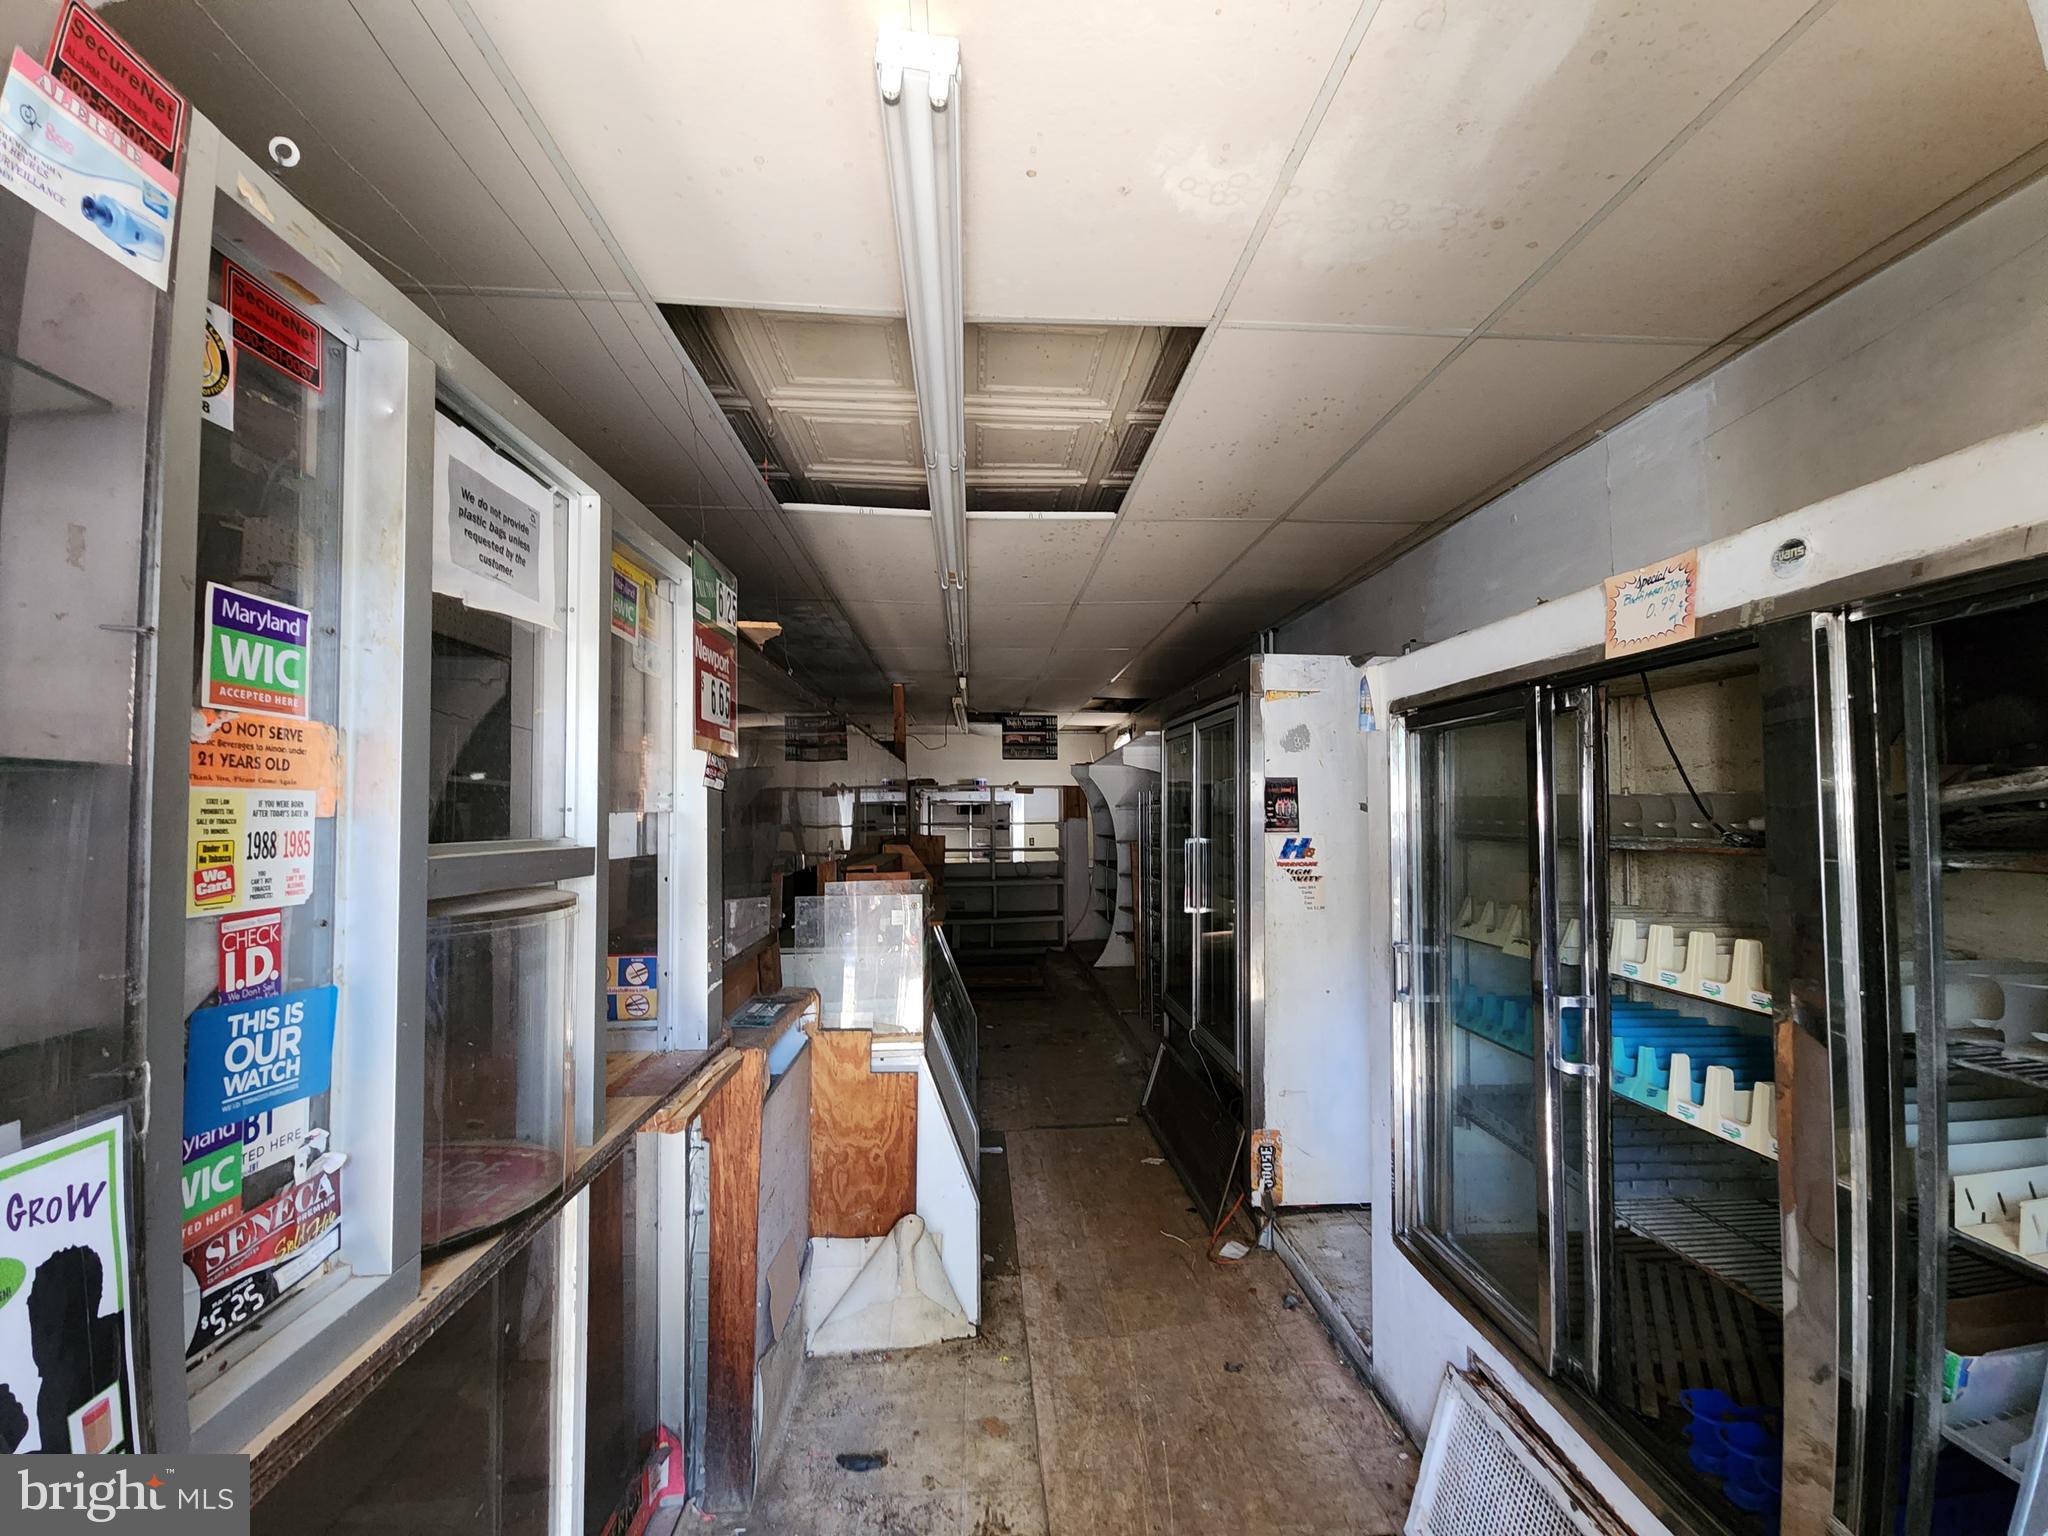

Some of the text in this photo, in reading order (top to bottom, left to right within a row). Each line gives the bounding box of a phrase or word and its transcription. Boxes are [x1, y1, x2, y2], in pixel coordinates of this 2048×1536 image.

[70, 17, 174, 121] SecureNet
[233, 280, 317, 345] SecureNet
[458, 506, 530, 552] plastic bags unless
[461, 486, 475, 504] We
[477, 498, 488, 511] do
[490, 505, 502, 520] not
[503, 514, 530, 536] provide
[464, 528, 526, 567] requested by the
[479, 553, 514, 578] customer.
[222, 598, 300, 637] Maryland
[221, 634, 300, 689] WIC
[695, 635, 730, 674] Newport
[219, 686, 298, 708] ACCEPTED HERE
[711, 679, 730, 719] 6.65
[237, 722, 265, 738] NOT
[269, 727, 303, 742] SERVE
[198, 751, 290, 771] 21 YEARS OLD
[246, 830, 311, 860] 1988 1985
[196, 878, 232, 895] Card
[201, 869, 227, 883] We
[222, 924, 280, 952] CHECK
[225, 945, 279, 993] I.D.
[228, 992, 241, 1001] We
[228, 1002, 304, 1037] THIS IS
[224, 1026, 302, 1073] OUR
[223, 1056, 300, 1097] WATCH
[183, 1122, 236, 1161] yland
[244, 1108, 273, 1146] BT
[270, 1128, 302, 1152] HERE
[6, 1181, 107, 1232] GROW
[205, 1204, 234, 1226] HERE
[205, 1172, 335, 1273] SENECA
[297, 1194, 336, 1225] PREMIUM
[200, 1283, 265, 1336] $5.25
